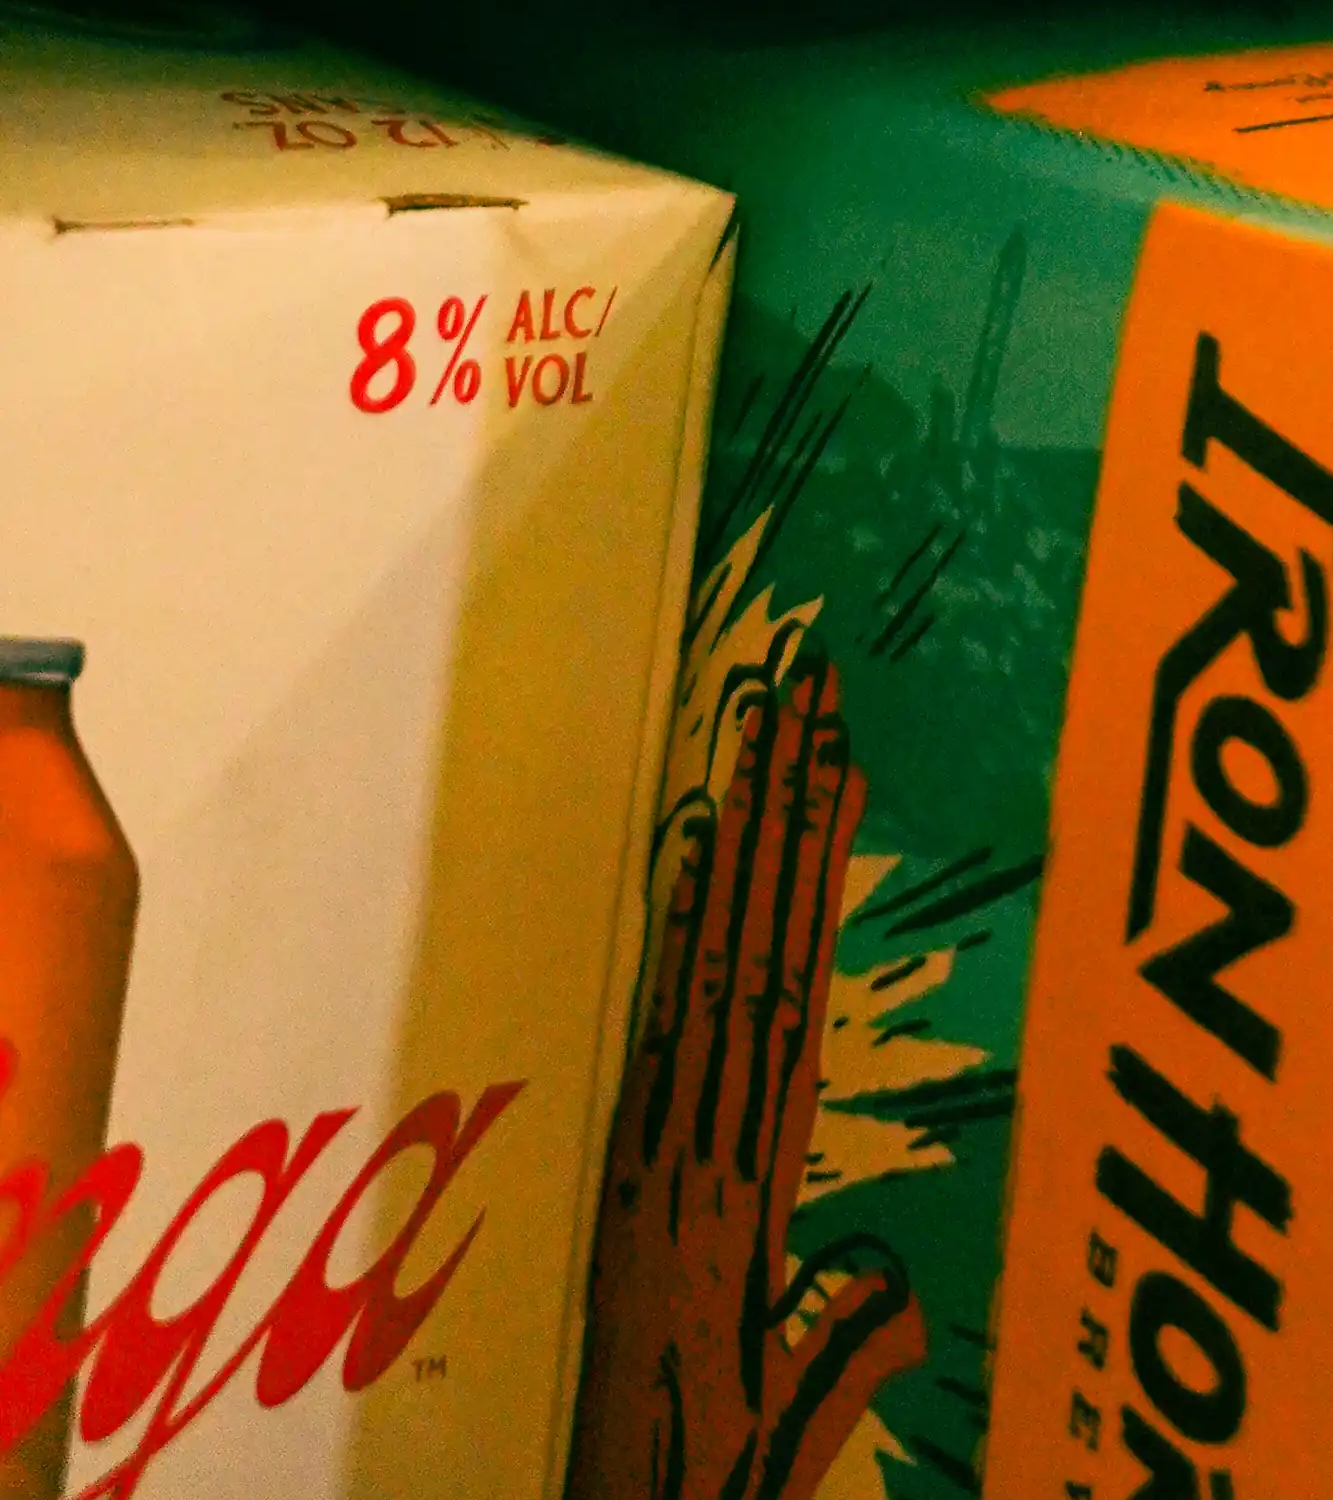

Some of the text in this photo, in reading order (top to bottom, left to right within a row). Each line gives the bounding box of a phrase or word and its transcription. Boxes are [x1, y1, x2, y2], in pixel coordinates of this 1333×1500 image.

[349, 286, 619, 414] 8% ALC/
[504, 352, 594, 408] VOL
[412, 1355, 448, 1382] TM
